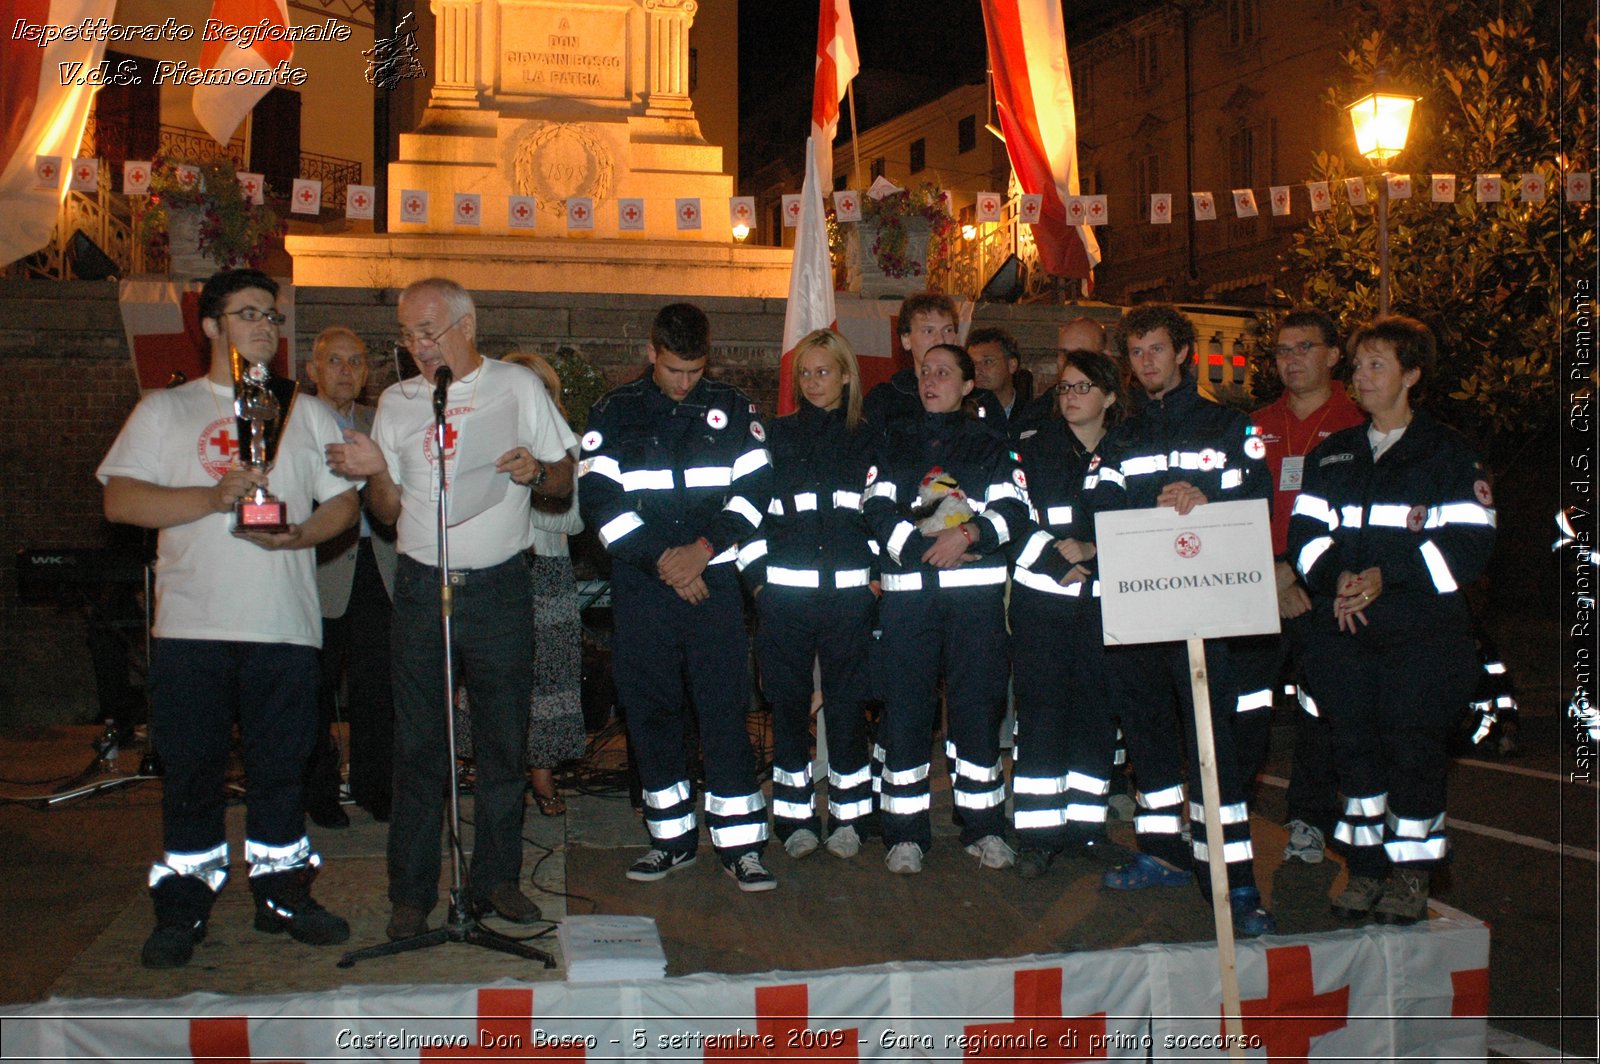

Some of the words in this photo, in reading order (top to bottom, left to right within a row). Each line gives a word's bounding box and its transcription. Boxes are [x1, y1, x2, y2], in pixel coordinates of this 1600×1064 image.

[558, 17, 570, 30] A
[548, 34, 580, 48] DON
[506, 50, 570, 66] GIOVANNI
[573, 54, 620, 69] BOSCO
[522, 69, 545, 83] LA
[550, 70, 601, 86] PATRIA
[1118, 570, 1262, 594] BORGOMANERO
